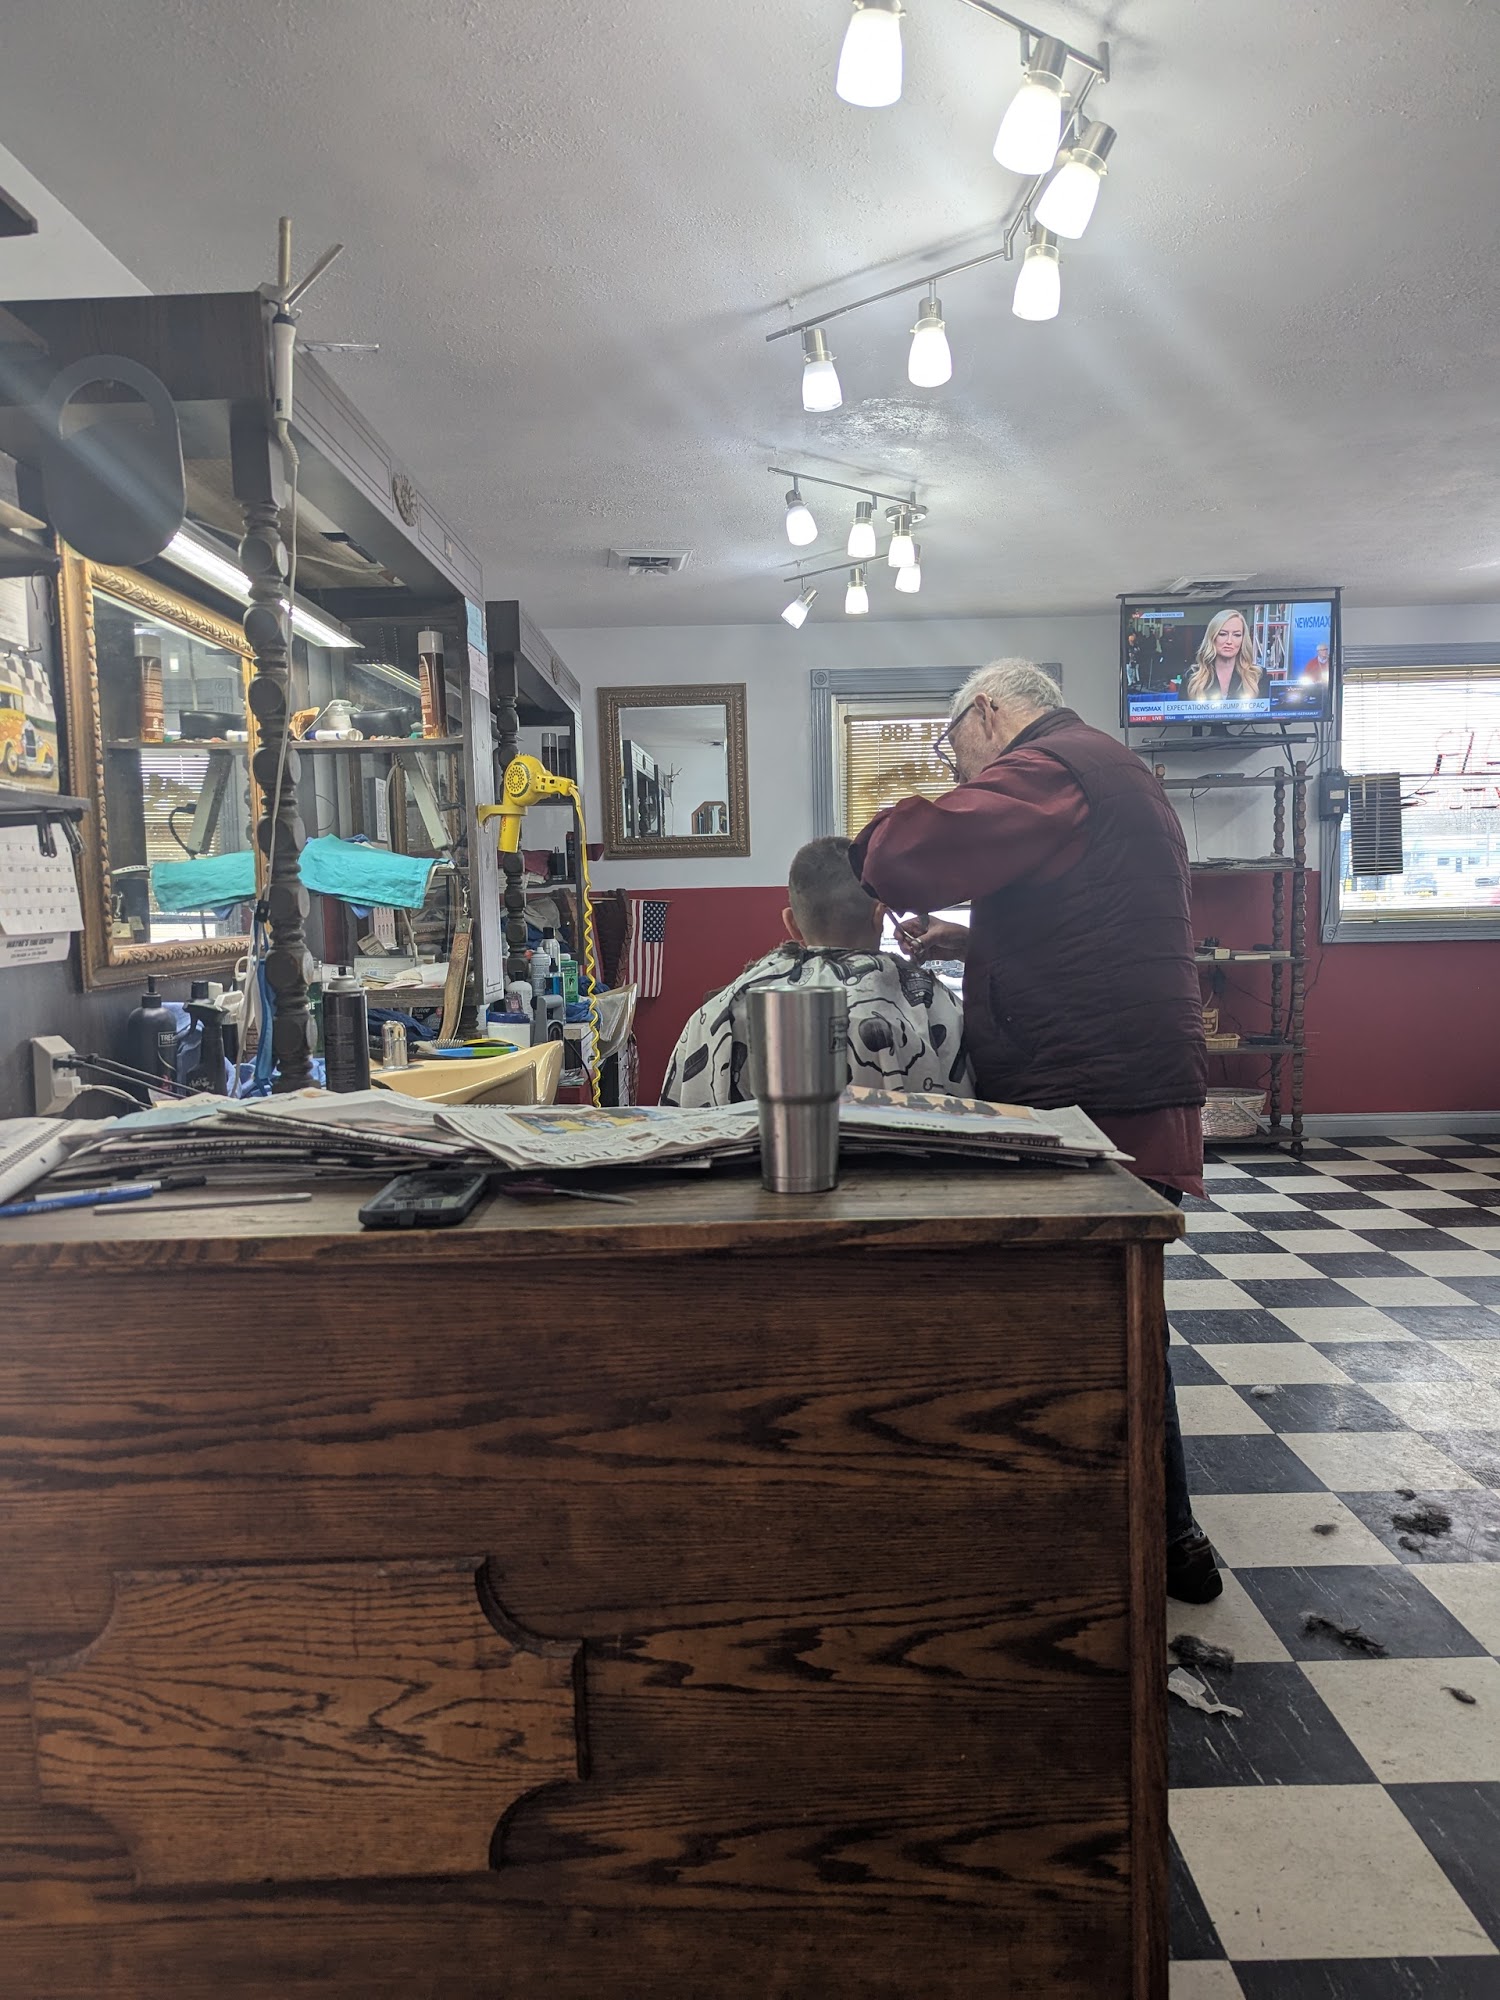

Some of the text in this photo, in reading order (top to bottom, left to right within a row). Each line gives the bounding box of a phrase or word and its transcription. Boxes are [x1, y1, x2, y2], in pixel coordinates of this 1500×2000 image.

[1294, 616, 1330, 629] NEWSMAX
[1166, 702, 1209, 712] EXPECTATIONS
[1220, 702, 1239, 710] TRUMP
[1249, 701, 1264, 709] CPAC
